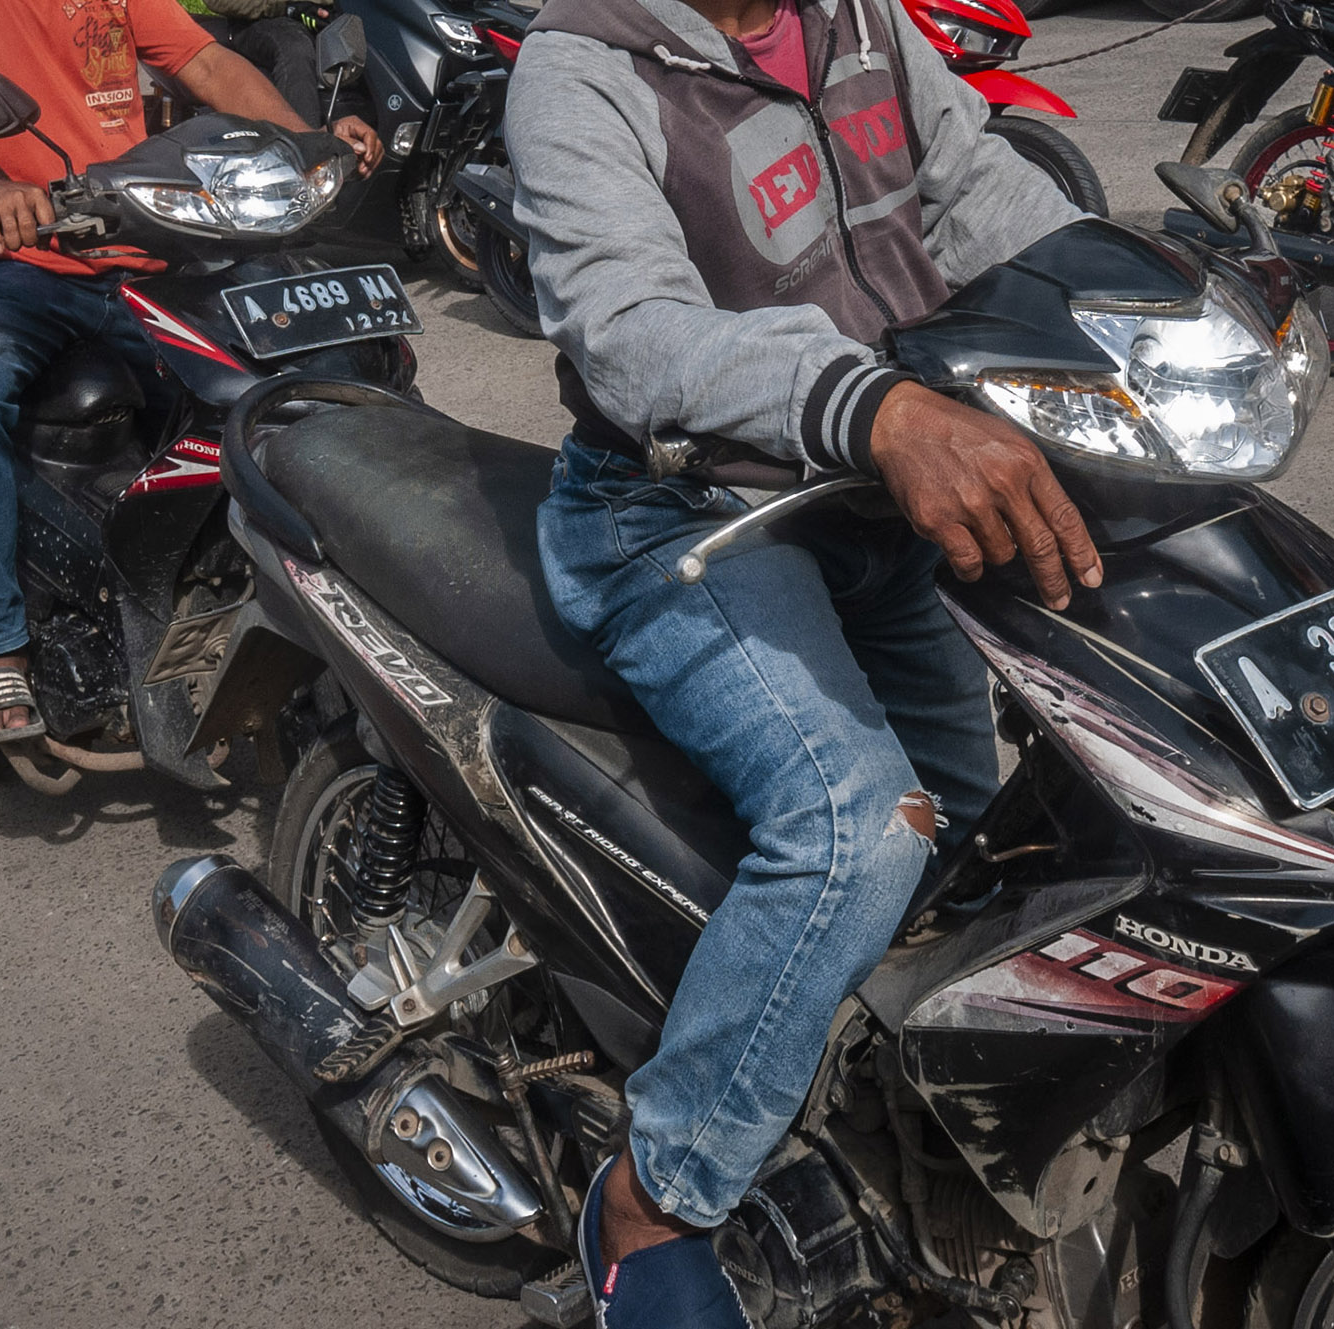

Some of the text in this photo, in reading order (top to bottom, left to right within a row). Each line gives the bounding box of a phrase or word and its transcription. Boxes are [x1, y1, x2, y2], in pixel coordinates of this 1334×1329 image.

[244, 296, 268, 323] A
[283, 280, 350, 314] 4689
[1238, 656, 1293, 719] A
[1037, 931, 1236, 1011] 110
[1117, 912, 1261, 972] HONDA
